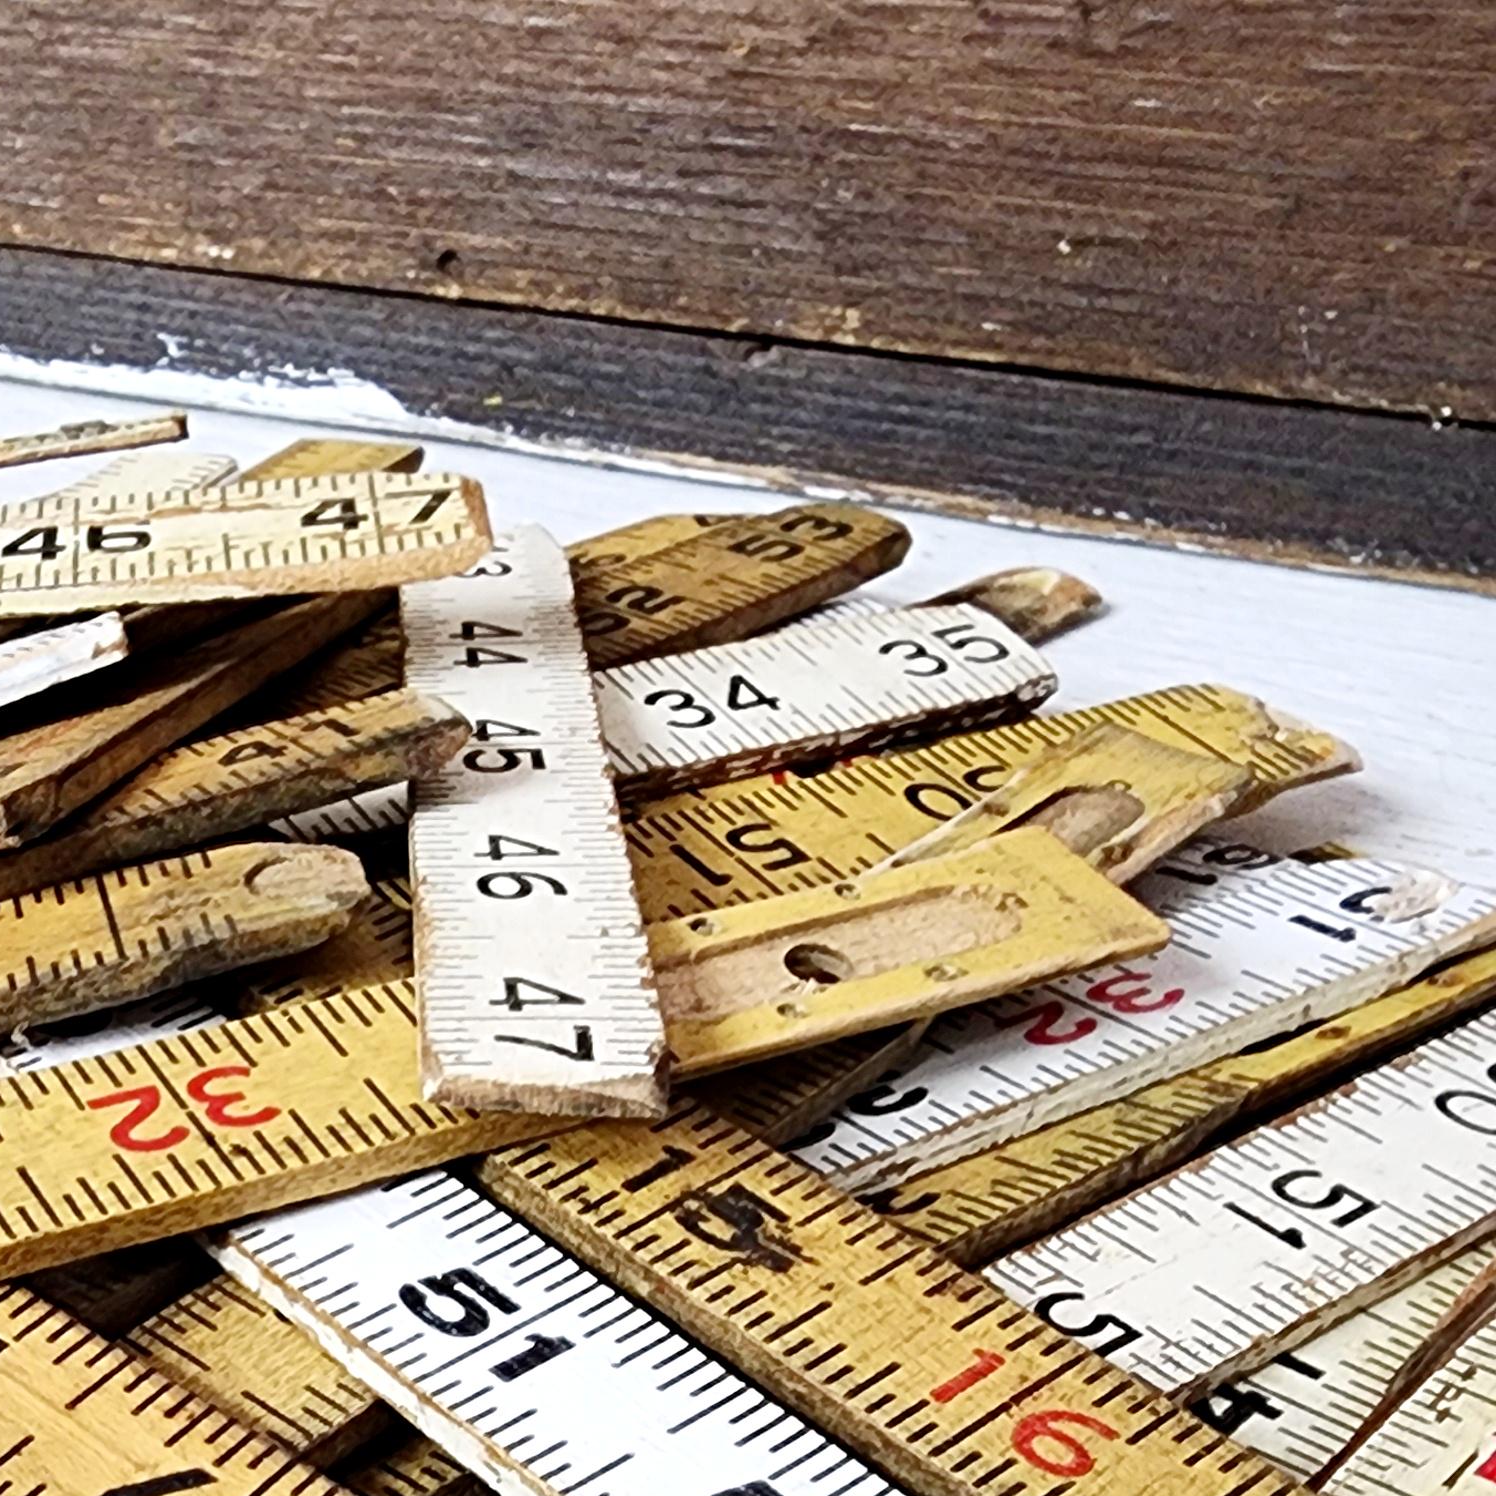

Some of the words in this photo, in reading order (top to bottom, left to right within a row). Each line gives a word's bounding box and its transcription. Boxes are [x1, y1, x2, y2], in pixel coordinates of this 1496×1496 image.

[3, 524, 153, 561] 46
[300, 489, 456, 532] 47
[726, 514, 854, 563] 53
[448, 620, 529, 668] 44
[644, 675, 780, 729] 34
[879, 624, 1010, 677] 35
[217, 718, 362, 767] 41
[462, 719, 547, 774] 45
[473, 833, 569, 900] 46
[669, 823, 812, 886] 51
[489, 976, 595, 1062] 47
[996, 972, 1185, 1046] 32
[87, 1065, 282, 1153] 32
[1224, 1169, 1381, 1250] 51
[399, 1266, 576, 1383] 51
[1033, 1292, 1143, 1356] 5
[930, 1348, 1122, 1478] 16
